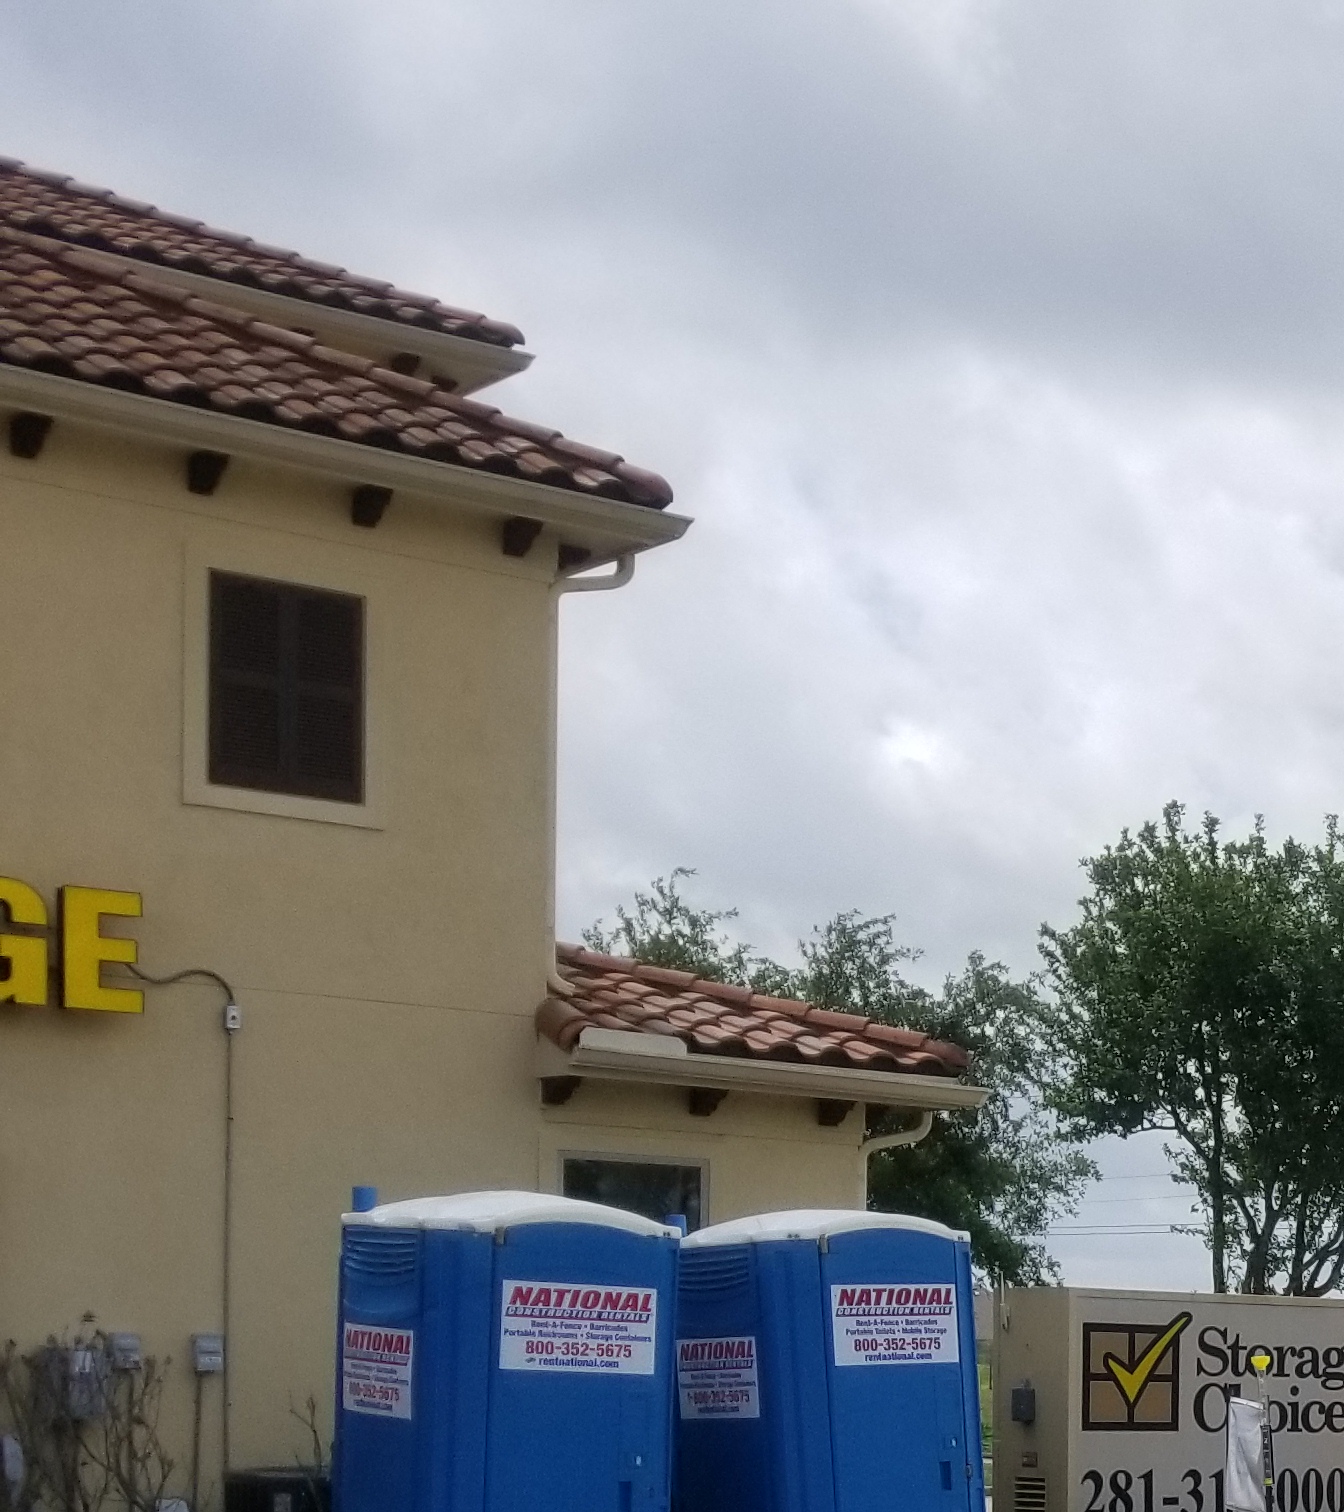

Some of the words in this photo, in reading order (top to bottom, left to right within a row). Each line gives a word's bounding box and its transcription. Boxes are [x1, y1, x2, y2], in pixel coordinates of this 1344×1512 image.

[508, 1286, 652, 1313] NATIONAL
[838, 1287, 954, 1307] NATIONAL
[507, 1306, 599, 1319] CONSTRUCTION
[600, 1311, 649, 1322] RENTALS
[345, 1328, 412, 1355] NATIONAL
[525, 1340, 632, 1358] 800-352-5675
[680, 1340, 754, 1361] NATIONAL
[854, 1337, 941, 1352] 800-352-5675
[538, 1356, 620, 1369] rentnational.com
[865, 1351, 933, 1362] rentnational.com
